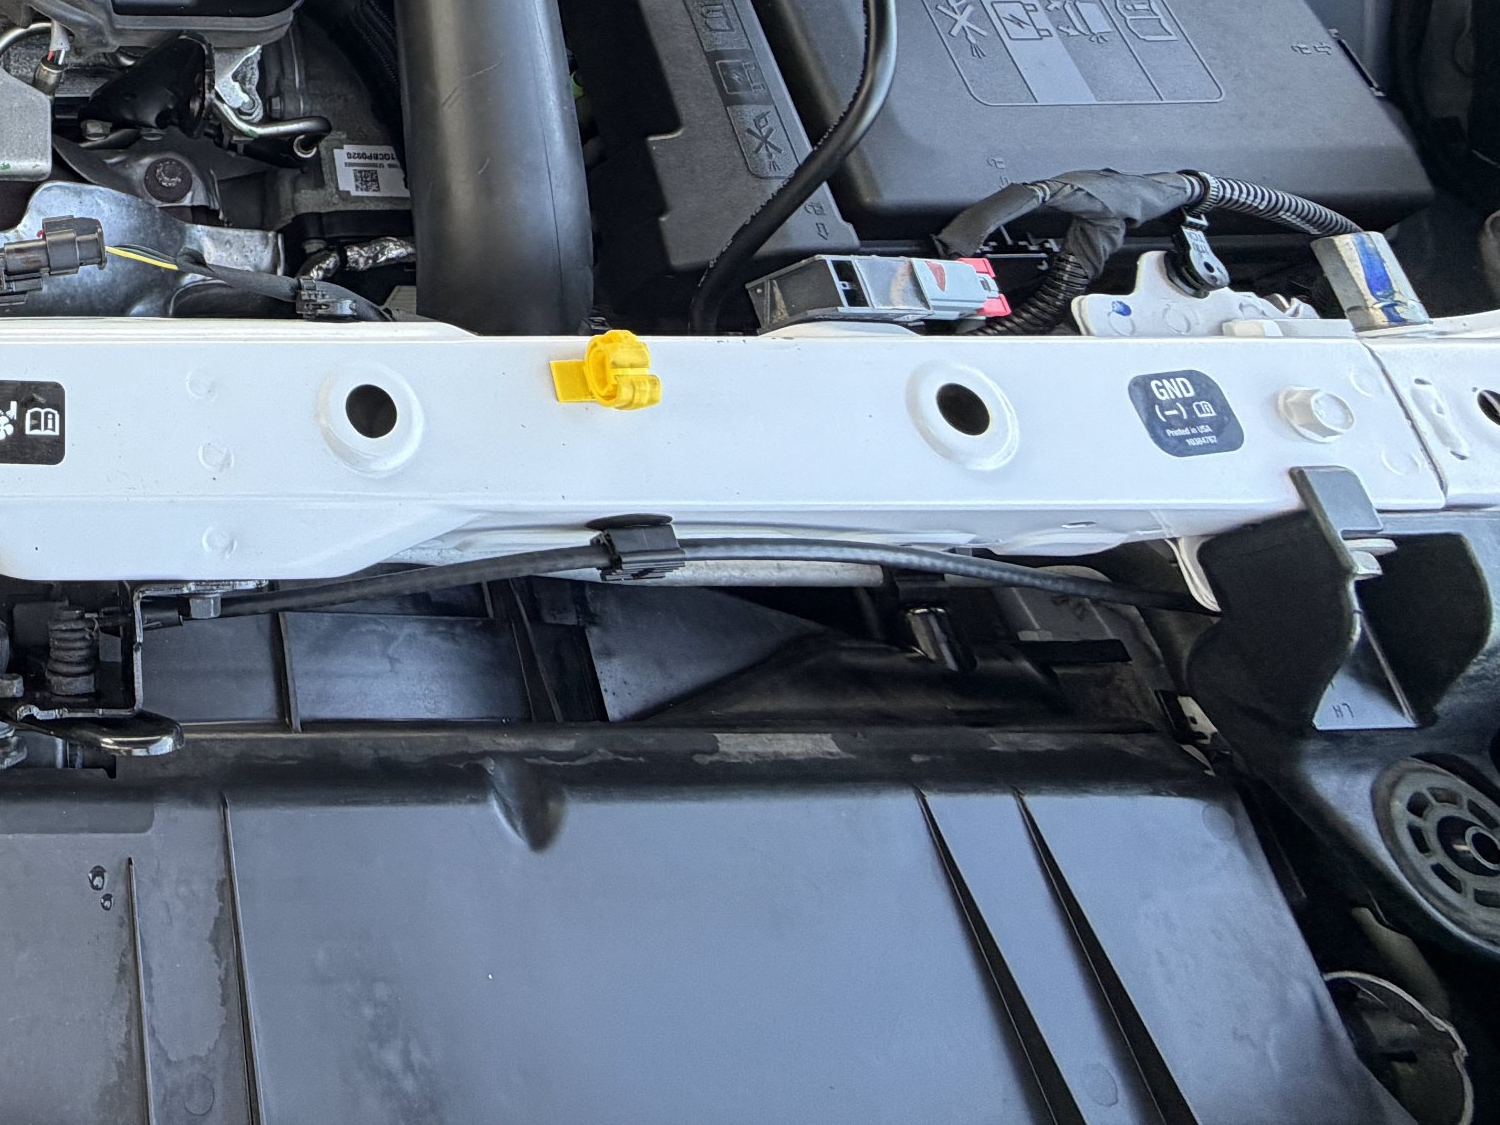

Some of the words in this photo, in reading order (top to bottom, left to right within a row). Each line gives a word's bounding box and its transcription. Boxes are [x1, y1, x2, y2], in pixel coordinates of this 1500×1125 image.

[1150, 377, 1196, 401] GND
[1165, 427, 1191, 437] Printed
[1197, 424, 1213, 434] USA
